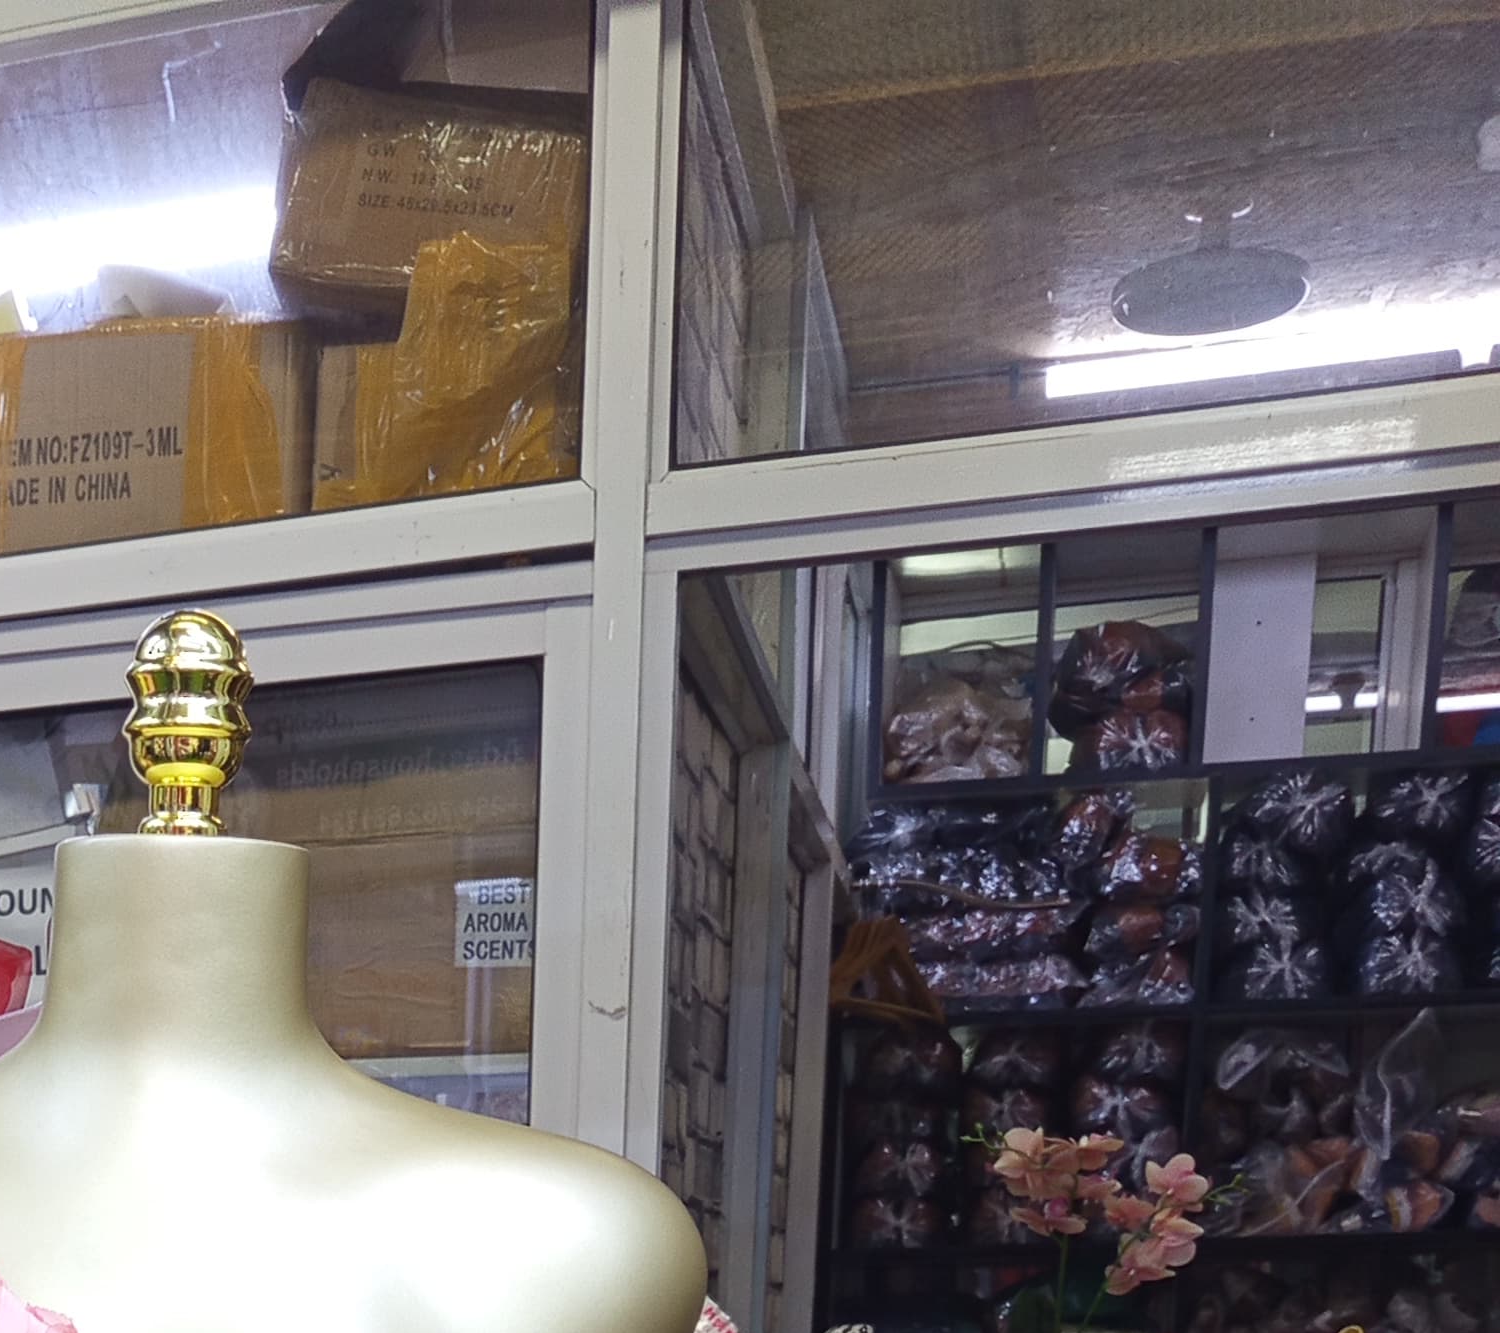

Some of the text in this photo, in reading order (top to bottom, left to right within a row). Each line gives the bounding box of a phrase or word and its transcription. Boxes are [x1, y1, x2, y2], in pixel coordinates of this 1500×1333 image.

[48, 476, 67, 504] IN
[75, 471, 132, 502] CHINA
[477, 882, 531, 905] BEST
[463, 912, 528, 933] AROMA
